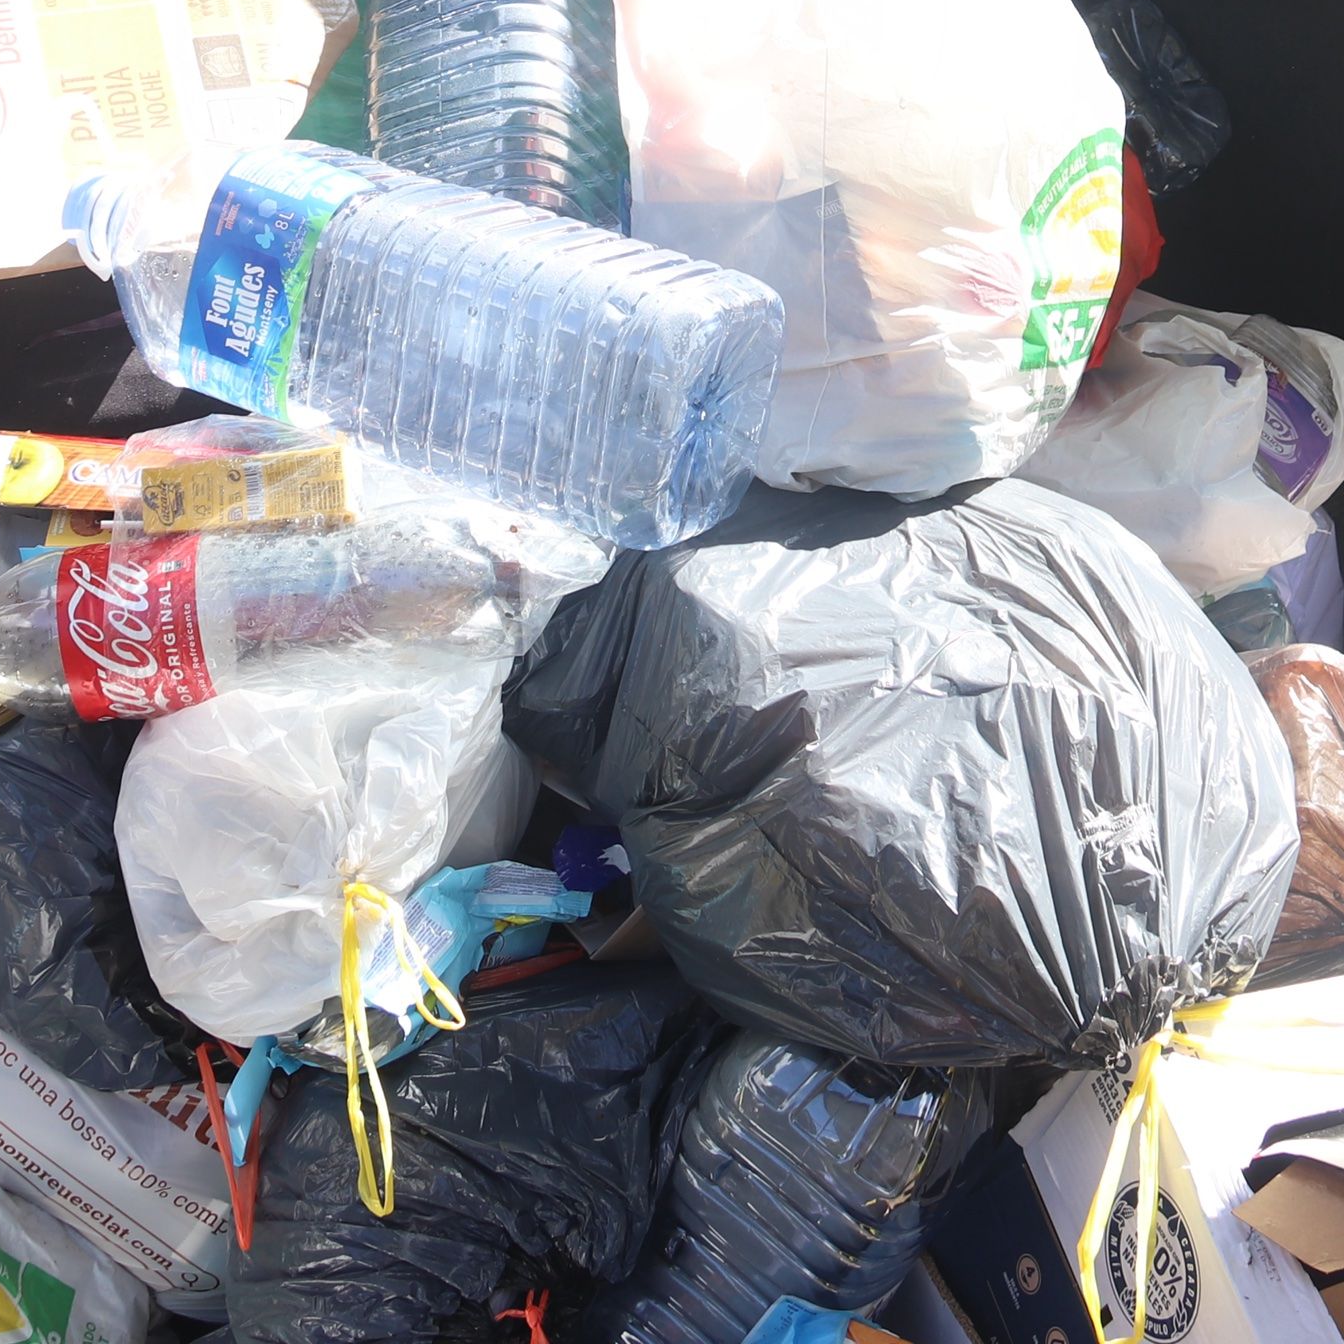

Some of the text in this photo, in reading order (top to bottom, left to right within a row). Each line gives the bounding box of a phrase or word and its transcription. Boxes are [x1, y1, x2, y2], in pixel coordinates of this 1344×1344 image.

[106, 66, 145, 140] MEDIA
[139, 69, 172, 130] NOCHE
[206, 274, 236, 328] Font
[225, 263, 265, 358] Agudes
[254, 285, 279, 348] Montseny
[159, 580, 185, 682] ORIGINAL
[183, 602, 201, 670] Refrescante
[18, 1065, 59, 1107] una
[57, 1098, 117, 1162] bossa
[117, 1156, 169, 1199] 100%
[1181, 1238, 1195, 1308] CEBADA
